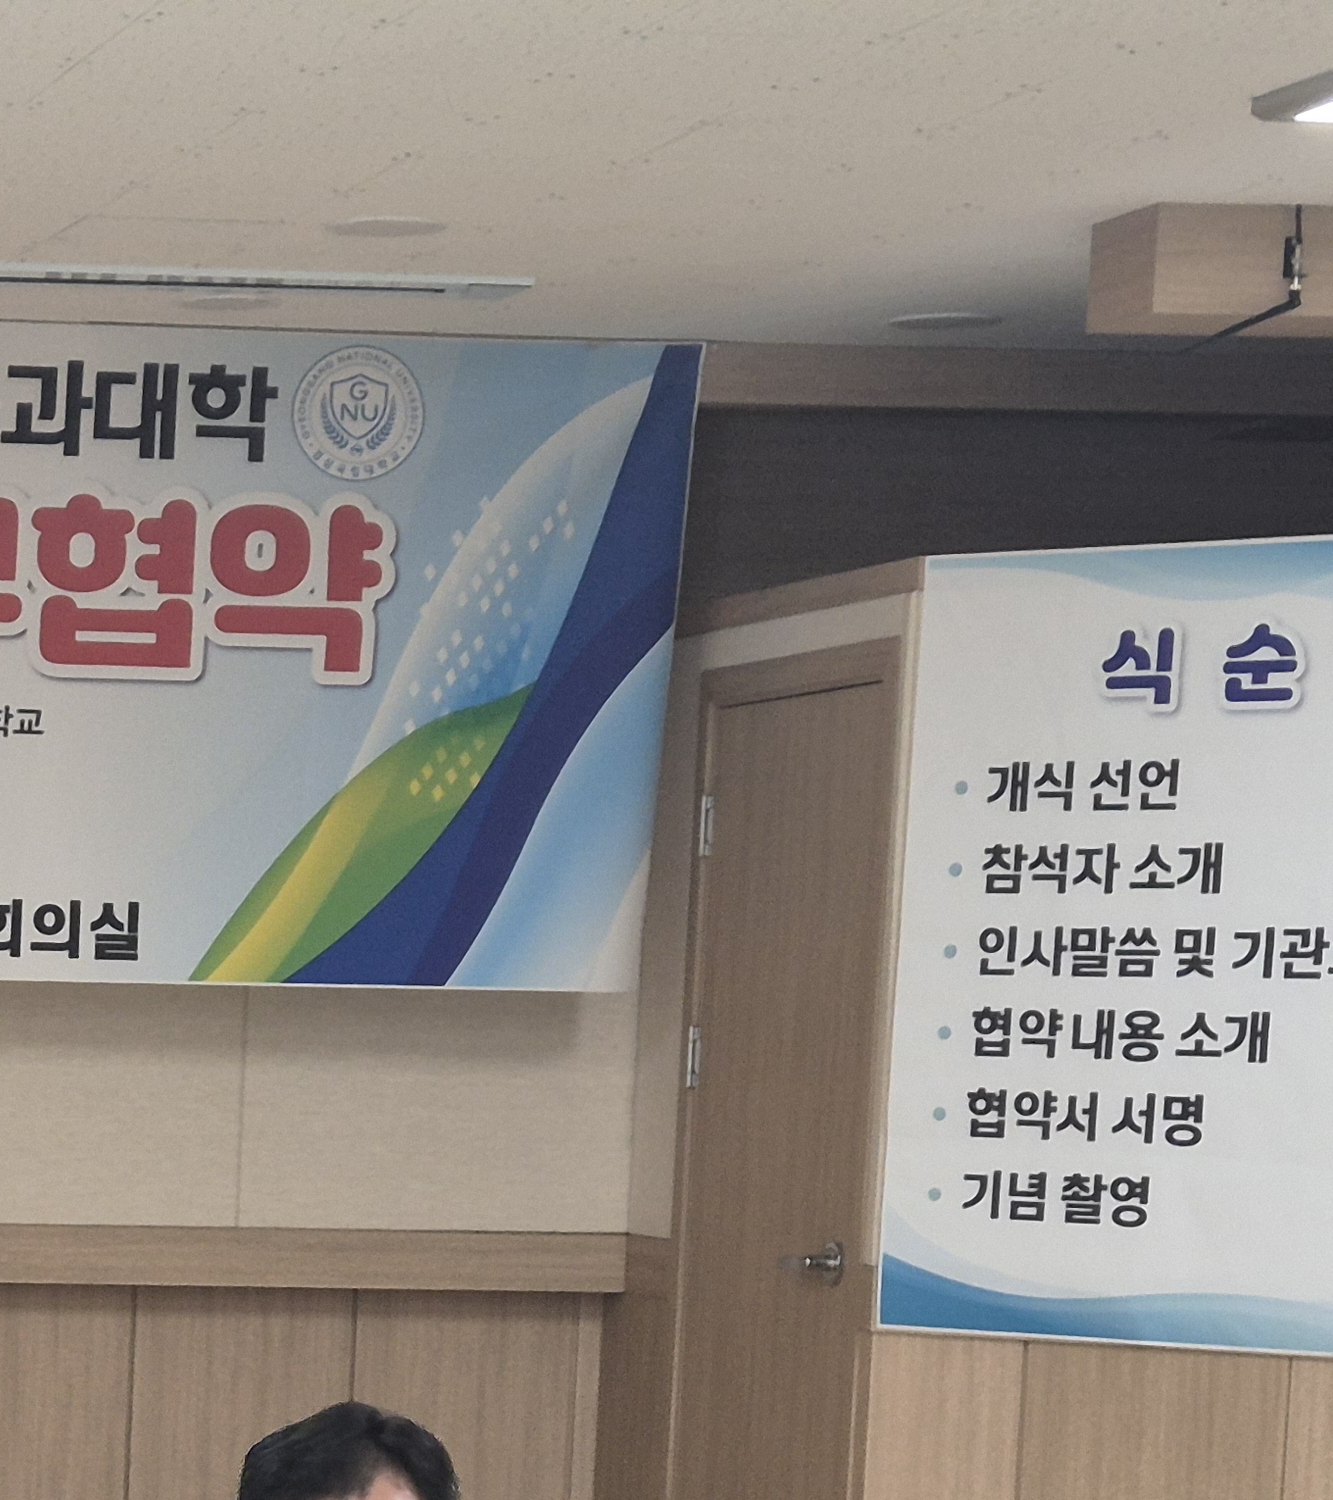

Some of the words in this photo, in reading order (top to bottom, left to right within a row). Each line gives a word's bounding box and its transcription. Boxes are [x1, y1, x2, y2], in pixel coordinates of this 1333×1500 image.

[986, 760, 1075, 812] 개식
[1089, 758, 1180, 812] 선언
[982, 843, 1121, 895] 참석자
[1129, 842, 1224, 895] 소개
[978, 925, 1161, 978] 인사말씀
[1174, 926, 1216, 978] 및
[1231, 926, 1333, 980] 기관
[972, 1006, 1064, 1059] 협약
[1071, 1009, 1165, 1063] 내용
[1175, 1011, 1271, 1064] 소개
[966, 1087, 1099, 1142] 협약서
[1111, 1092, 1204, 1147] 서명
[962, 1170, 1047, 1222] 기념
[1060, 1173, 1150, 1228] 촬영
